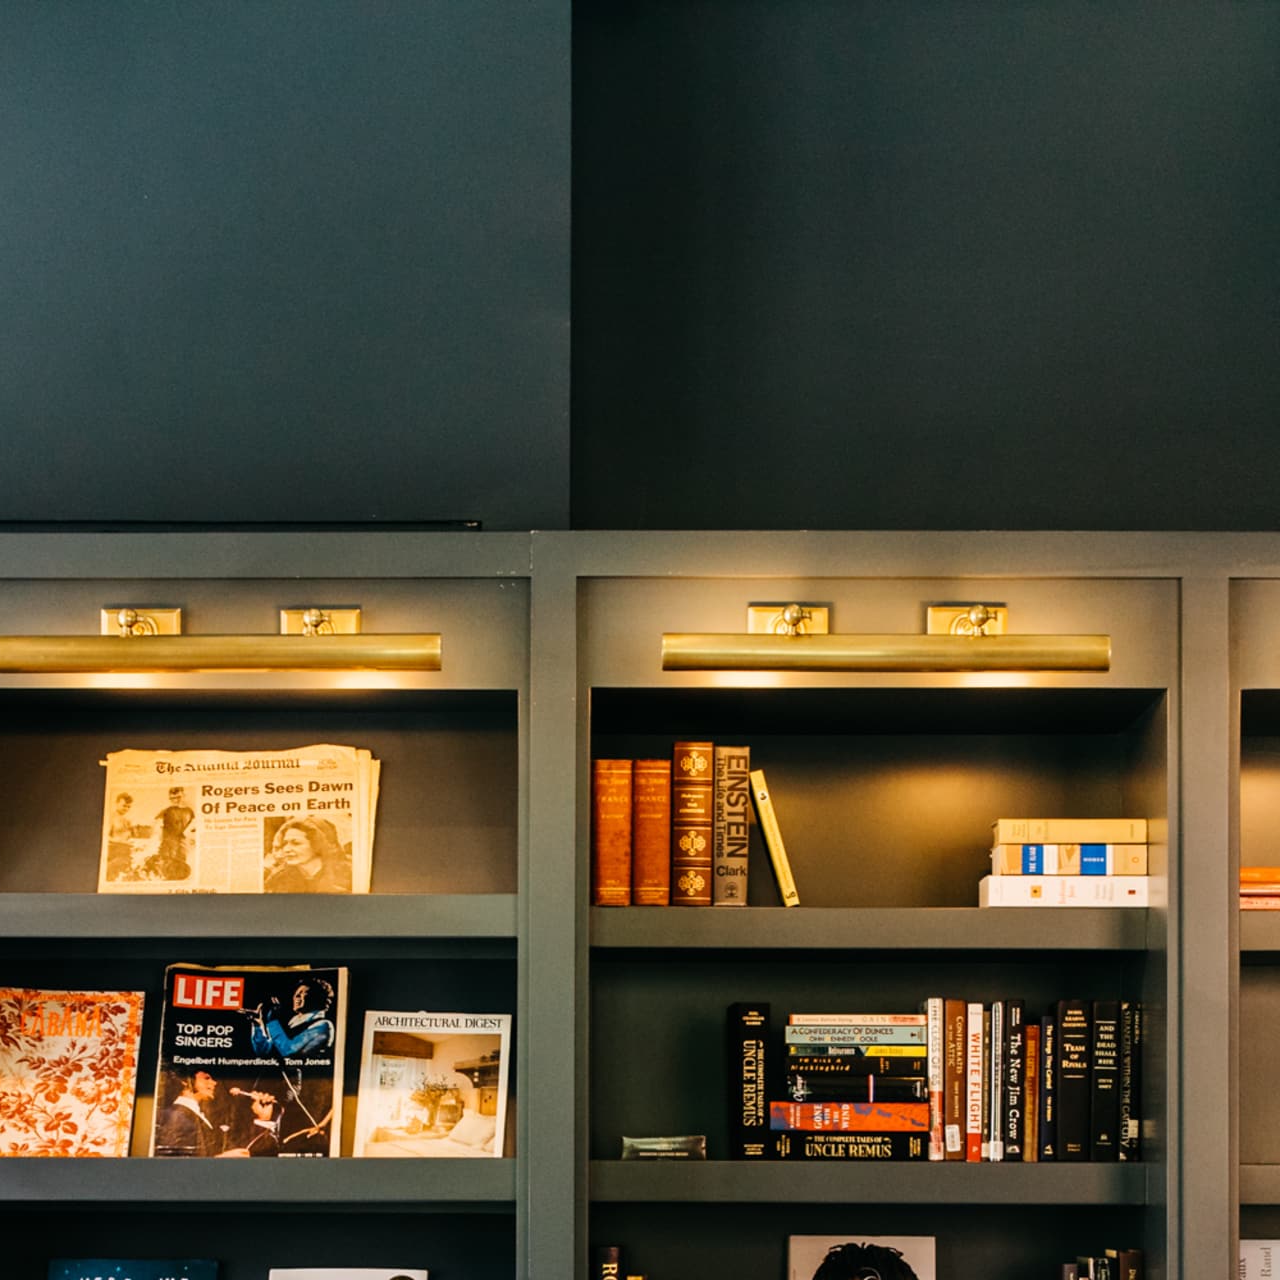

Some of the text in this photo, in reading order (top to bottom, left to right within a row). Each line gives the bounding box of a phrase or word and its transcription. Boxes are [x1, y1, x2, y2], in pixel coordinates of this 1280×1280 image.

[155, 760, 181, 775] The
[201, 780, 354, 799] Rogers Sees Dawn
[201, 798, 351, 815] Of Peace on Earth
[716, 757, 727, 858] The Life and Times
[727, 755, 749, 859] EINSTEIN
[716, 866, 747, 877] Clark
[176, 977, 241, 1007] LIFE
[176, 1023, 234, 1036] TOP POP
[374, 1016, 503, 1029] ARCHITECTURAL DIGEST
[175, 1035, 233, 1048] SINGERS
[1063, 1043, 1085, 1052] TEAM
[173, 1055, 331, 1067] Engelbert Humperdinck, Tom Jones
[1062, 1060, 1087, 1068] RIVALS
[742, 1040, 756, 1126] UNCLE REMUS
[970, 1033, 981, 1130] WHITE FLIGHT
[1008, 1033, 1021, 1139] The New Jim Crow
[805, 1144, 892, 1158] UNCLE REMUS
[1259, 1248, 1272, 1277] Rand
